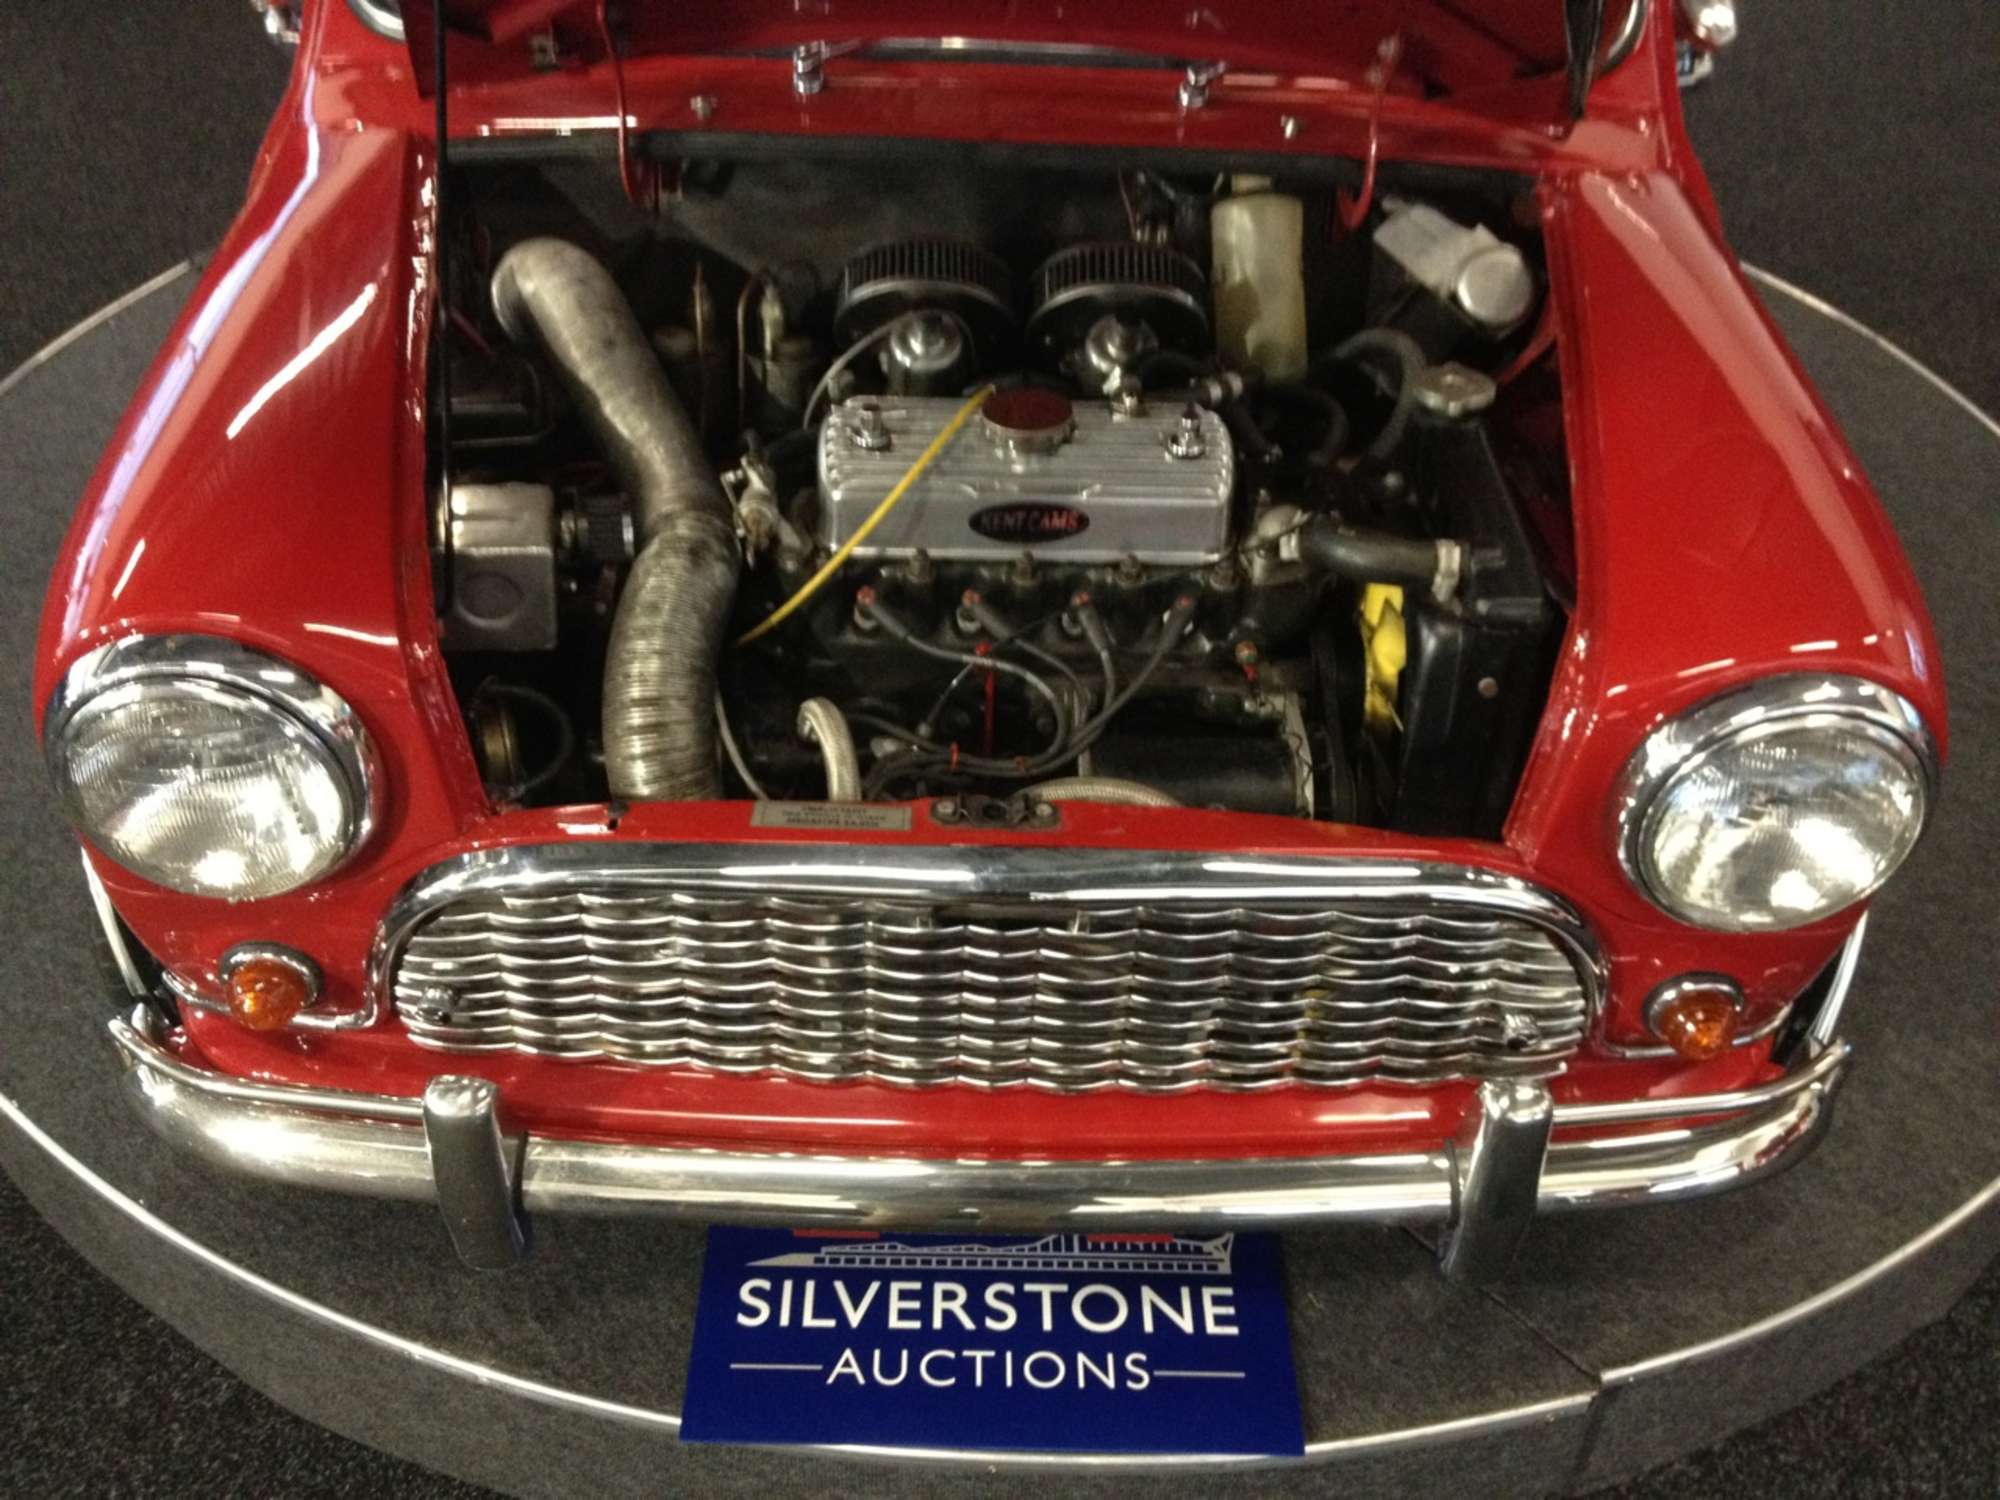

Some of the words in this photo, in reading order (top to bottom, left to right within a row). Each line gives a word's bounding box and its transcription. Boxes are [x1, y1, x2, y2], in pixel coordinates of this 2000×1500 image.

[1026, 509, 1079, 532] CAMS
[736, 1278, 1240, 1336] SILVERSTONE
[826, 1347, 1151, 1391] AUCTIONS
